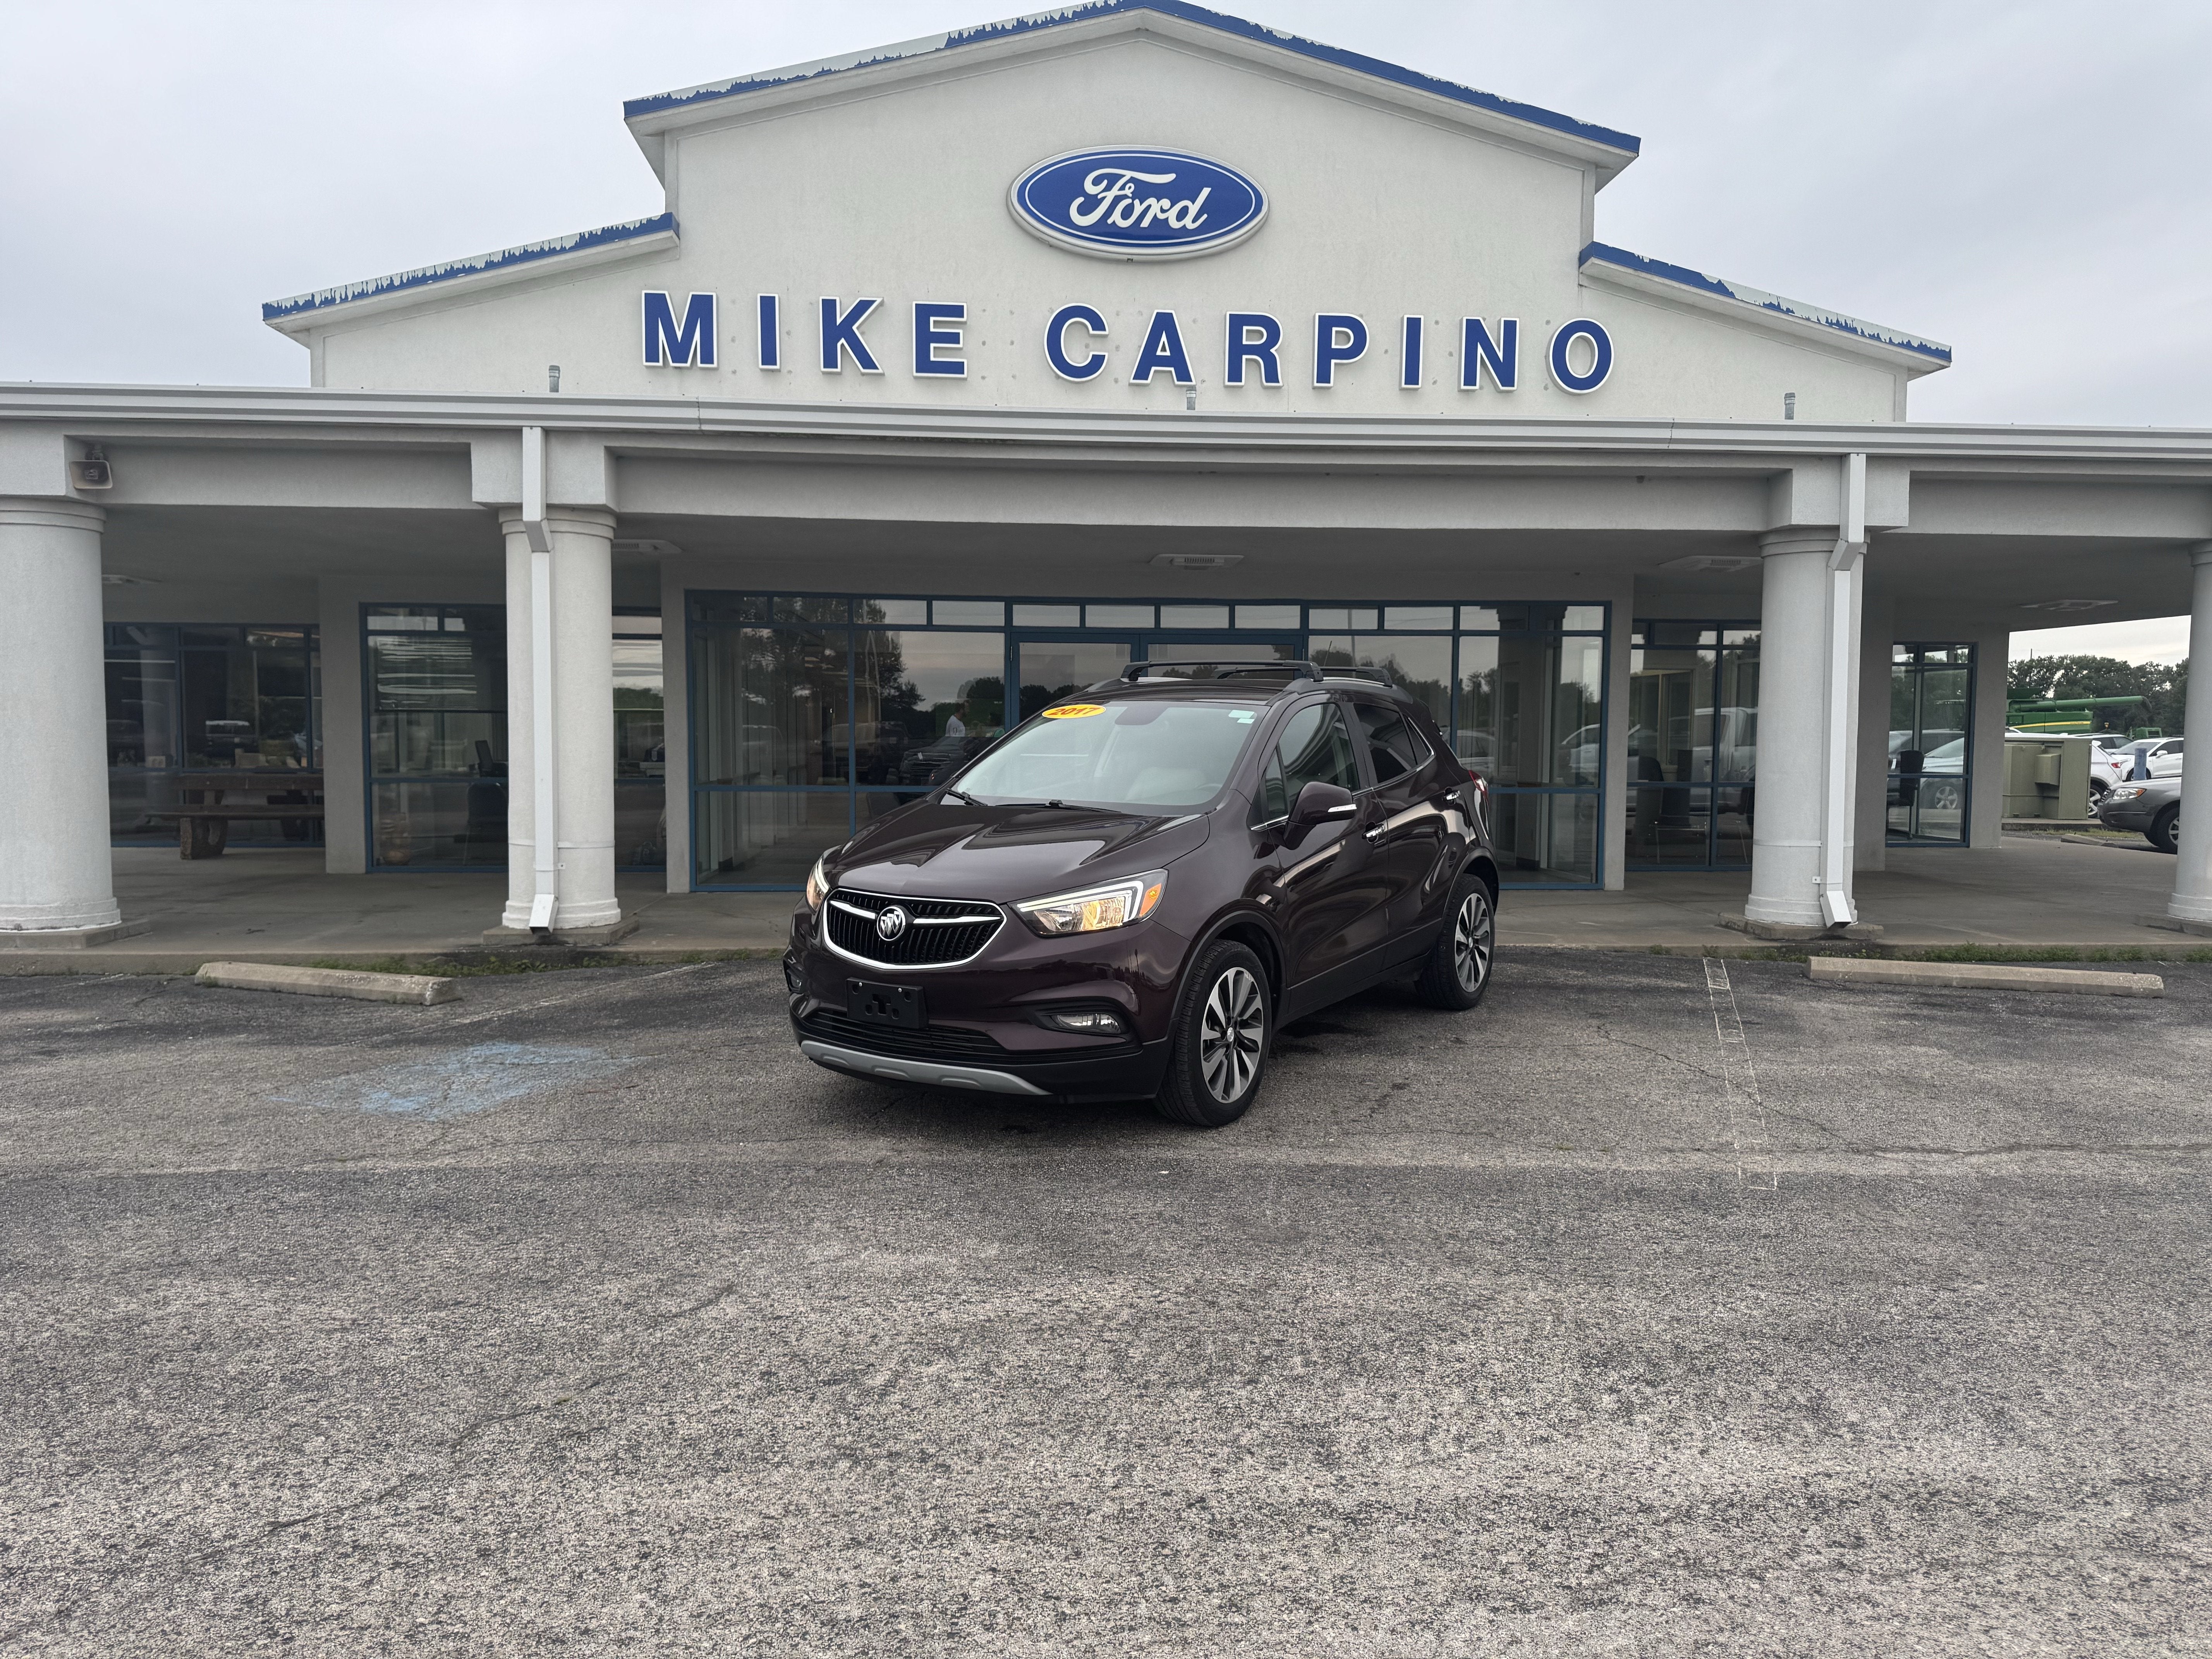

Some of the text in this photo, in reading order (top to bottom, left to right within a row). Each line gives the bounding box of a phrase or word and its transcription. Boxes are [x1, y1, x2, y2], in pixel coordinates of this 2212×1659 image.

[1070, 168, 1211, 229] Ford
[642, 291, 1614, 392] MIKE CARPINO
